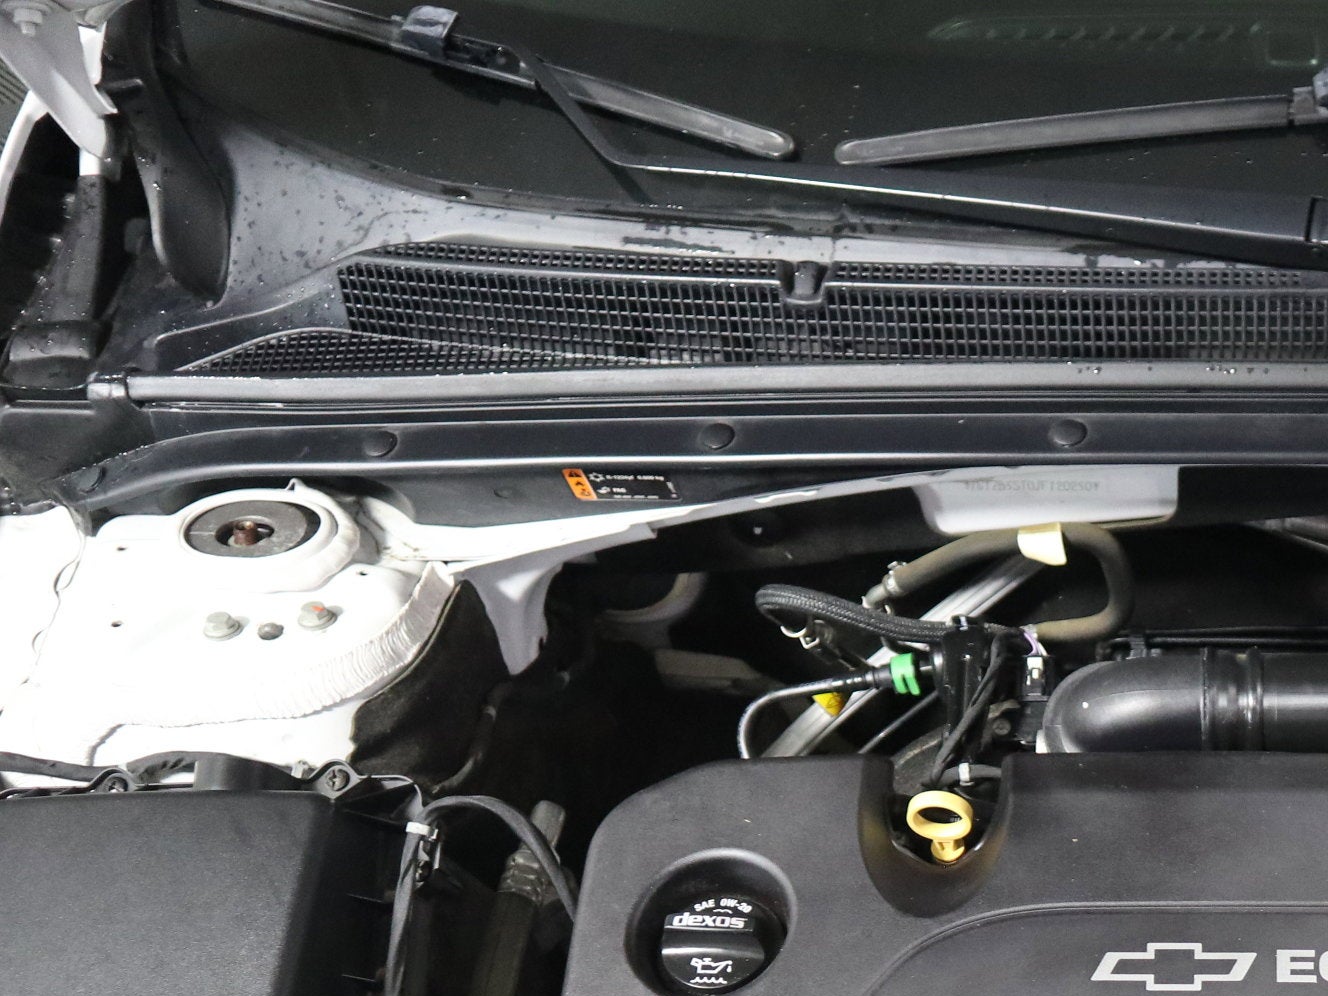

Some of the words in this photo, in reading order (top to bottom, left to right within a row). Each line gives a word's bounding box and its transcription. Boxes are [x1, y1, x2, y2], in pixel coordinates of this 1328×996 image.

[694, 899, 716, 912] SAE
[720, 898, 752, 913] 0W-20
[672, 912, 748, 928] dexos
